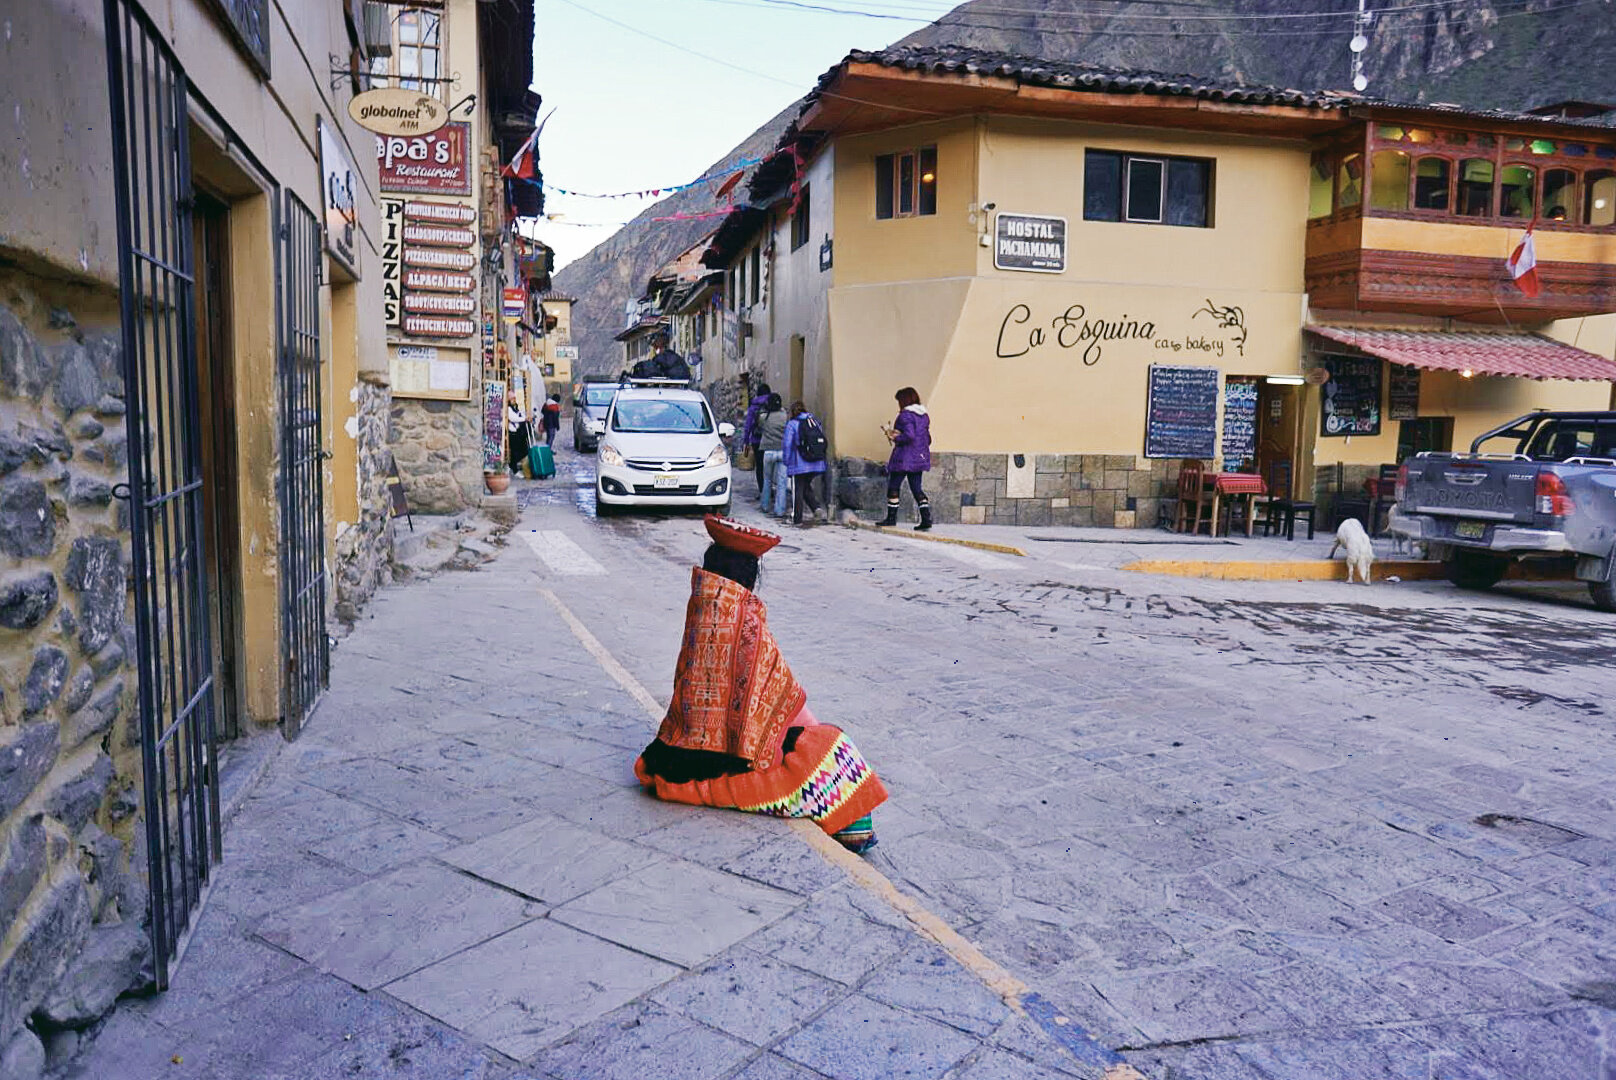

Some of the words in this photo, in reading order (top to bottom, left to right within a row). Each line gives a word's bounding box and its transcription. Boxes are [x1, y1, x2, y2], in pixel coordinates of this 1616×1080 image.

[361, 105, 420, 119] globalnet
[400, 120, 419, 130] ATM
[396, 164, 460, 178] Restaurant
[1007, 221, 1054, 239] HOSTAL
[1000, 239, 1060, 259] PACHAMAMA
[383, 203, 402, 320] PIZZAS
[407, 273, 472, 289] ALPACA/BEEF
[996, 304, 1046, 358] La
[1052, 304, 1156, 366] Esquina
[1425, 488, 1508, 509] TOYOTA
